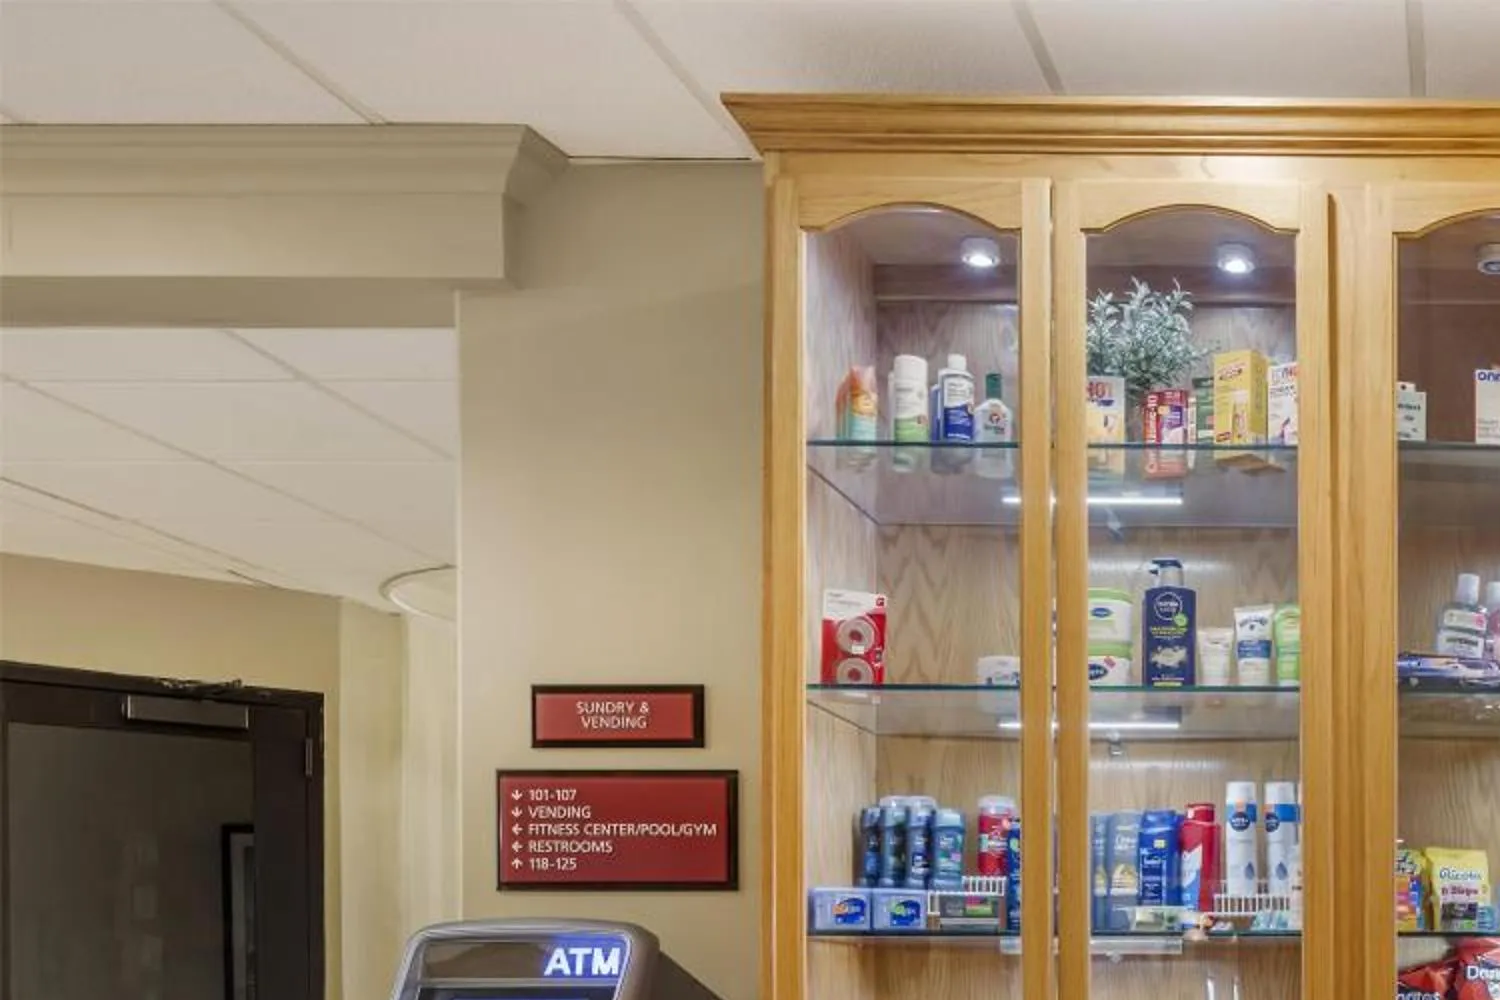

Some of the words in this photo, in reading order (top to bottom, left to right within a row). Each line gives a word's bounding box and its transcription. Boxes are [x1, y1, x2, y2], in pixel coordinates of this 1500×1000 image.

[576, 701, 634, 714] SUNDRY
[639, 701, 650, 713] &
[581, 716, 648, 729] VENDING
[528, 789, 578, 801] 101-107
[528, 805, 592, 819] VENDING
[528, 823, 581, 836] FITNESS
[583, 823, 718, 836] CENTER/POOL/GYM
[528, 841, 614, 854] RESTROOMS
[528, 858, 578, 870] 118-125
[543, 947, 621, 976] ATM
